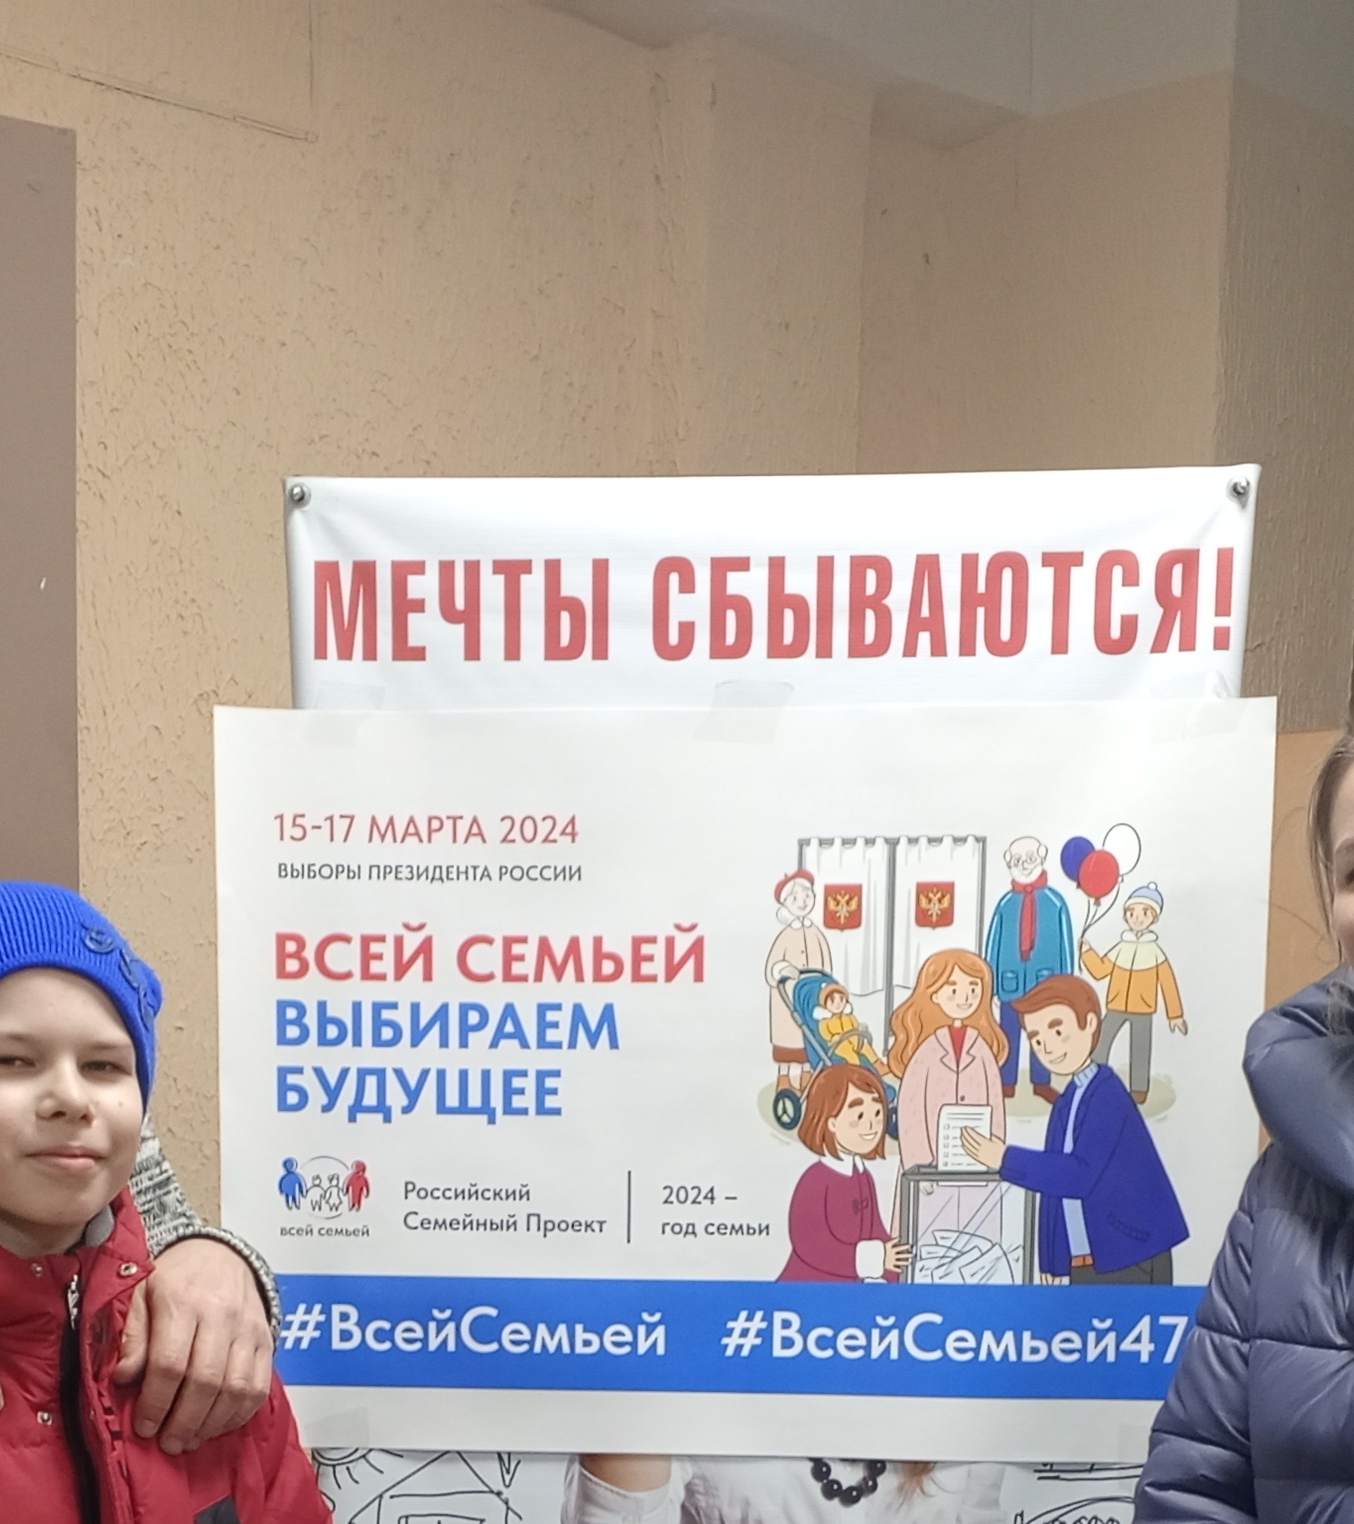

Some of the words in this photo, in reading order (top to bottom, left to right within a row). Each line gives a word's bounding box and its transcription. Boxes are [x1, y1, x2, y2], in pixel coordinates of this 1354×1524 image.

[312, 557, 609, 662] МЕЧТЫ
[651, 547, 1235, 658] СБЫВАЮТСЯ!
[274, 813, 357, 844] 15-17
[367, 814, 489, 844] МАРТА
[499, 814, 580, 844] 2024
[277, 862, 362, 881] ВЫБОРЫ
[367, 863, 492, 883] ПРЕЗИДЕНТА
[498, 863, 582, 882] РОССИИ
[274, 921, 435, 983] ВСЕЙ
[456, 923, 706, 985] СЕМЬЕЙ
[275, 1001, 621, 1051] ВЫБИРАЕМ
[275, 1066, 563, 1125] БУДУЩЕЕ
[403, 1181, 531, 1203] Российский
[661, 1184, 716, 1206] 2024
[279, 1225, 314, 1237] всей
[317, 1225, 371, 1238] семьей
[403, 1211, 518, 1233] Семейный
[525, 1213, 607, 1238] Проект
[661, 1222, 698, 1239] год
[703, 1222, 771, 1238] семьи
[280, 1303, 668, 1357] #ВсейСемьей
[721, 1309, 1189, 1365] #ВсейСемьей47
